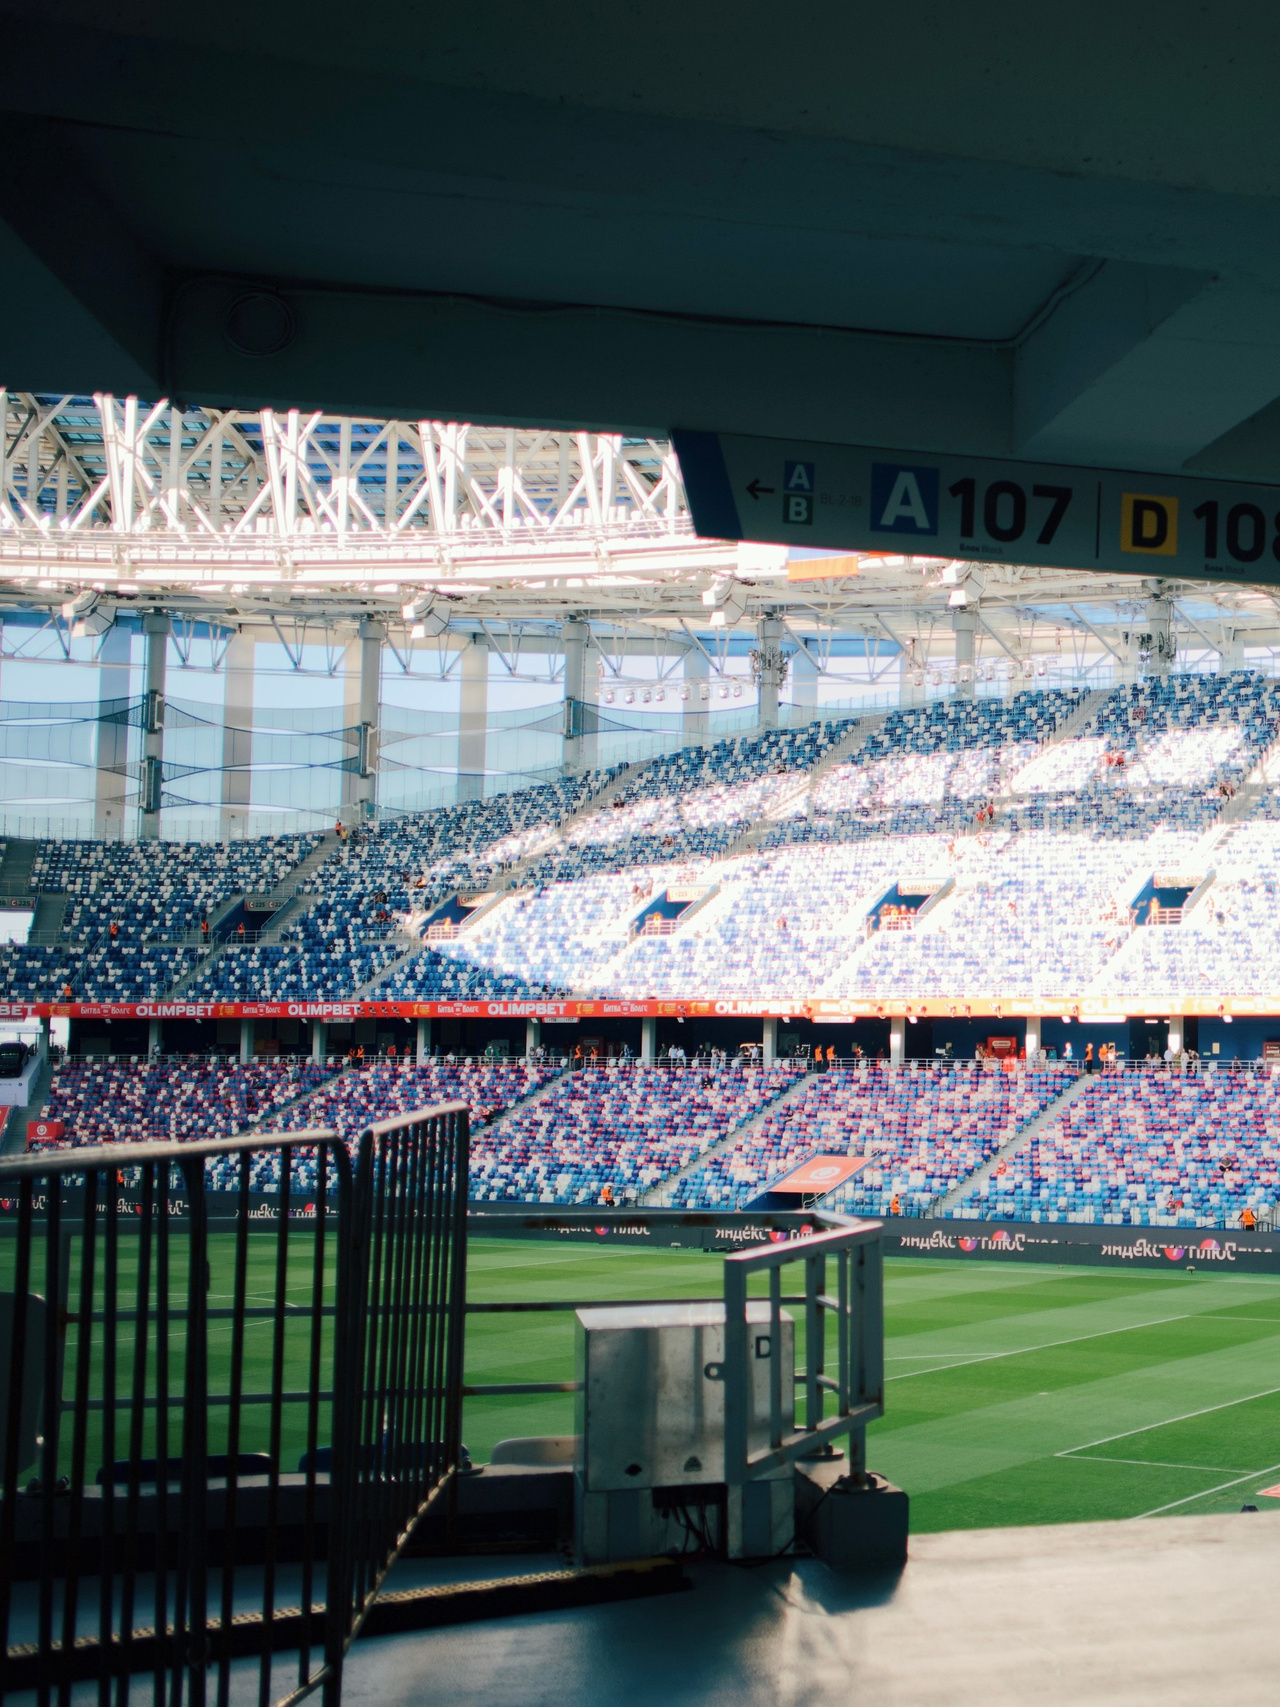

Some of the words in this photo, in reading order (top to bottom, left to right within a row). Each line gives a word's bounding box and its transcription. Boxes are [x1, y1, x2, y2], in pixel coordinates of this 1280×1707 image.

[788, 463, 811, 490] A
[788, 496, 809, 522] B
[879, 470, 931, 529] A
[948, 477, 1073, 545] 107
[1131, 498, 1168, 549] D
[959, 543, 980, 553] Блок
[981, 544, 1004, 555] Block
[1204, 563, 1223, 573] Блок
[136, 1004, 215, 1017] OLIMPBET
[288, 1004, 361, 1016] OLIMPBET
[488, 1003, 567, 1015] OLIMPBET
[715, 1000, 804, 1014] OLIMPBET
